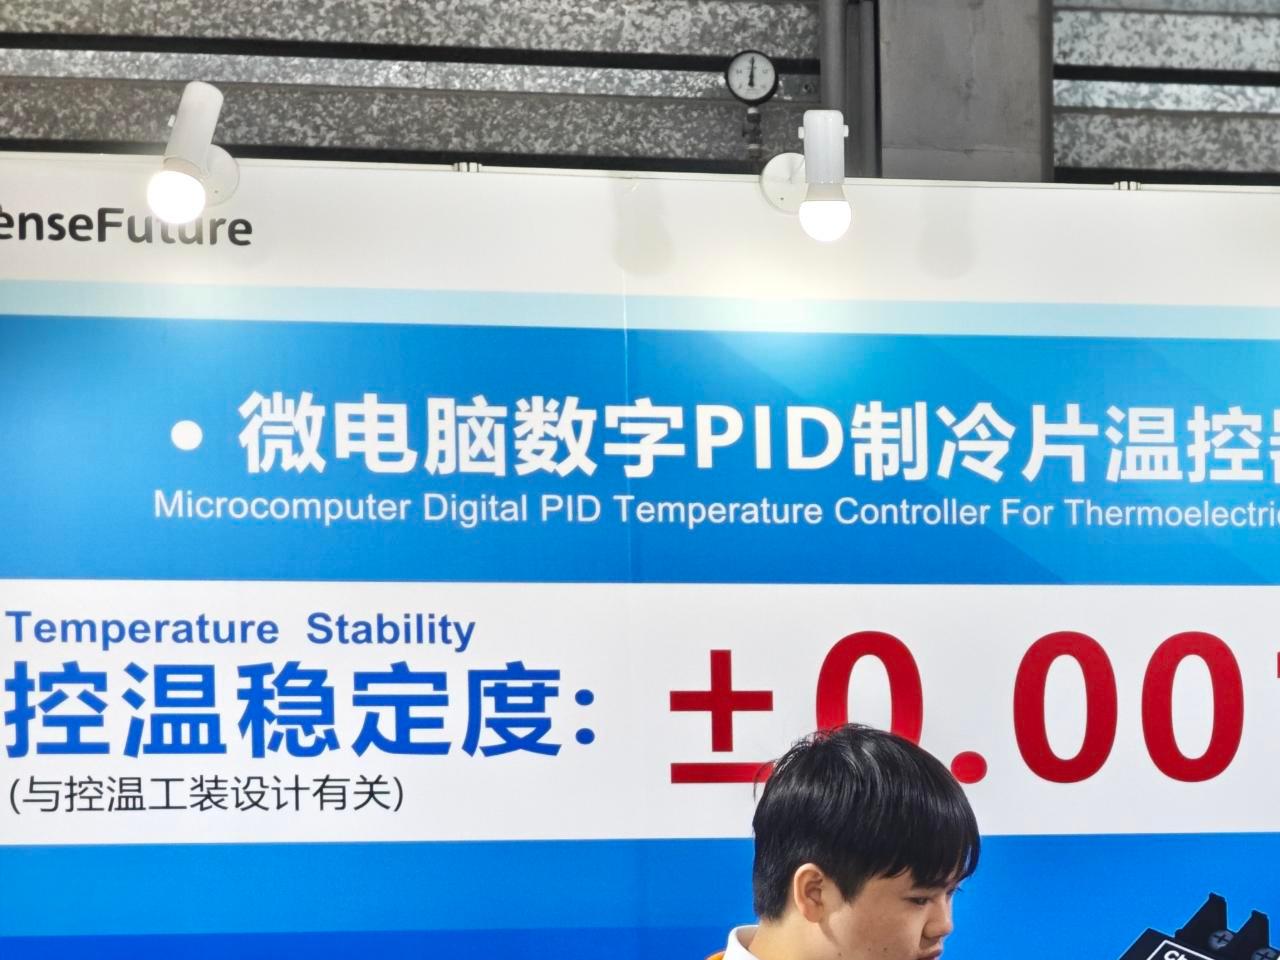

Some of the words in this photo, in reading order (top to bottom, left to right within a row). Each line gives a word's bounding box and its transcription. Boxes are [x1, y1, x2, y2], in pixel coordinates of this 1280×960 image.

[153, 489, 411, 524] Microcomputer
[423, 492, 529, 528] Digital
[541, 494, 601, 524] PID
[617, 495, 823, 529] Temperature
[834, 496, 990, 527] Controller
[1002, 498, 1054, 527] For
[6, 610, 280, 652] Temperature
[306, 612, 477, 653] Stability
[9, 774, 405, 814] (与控温工装设计有关)
